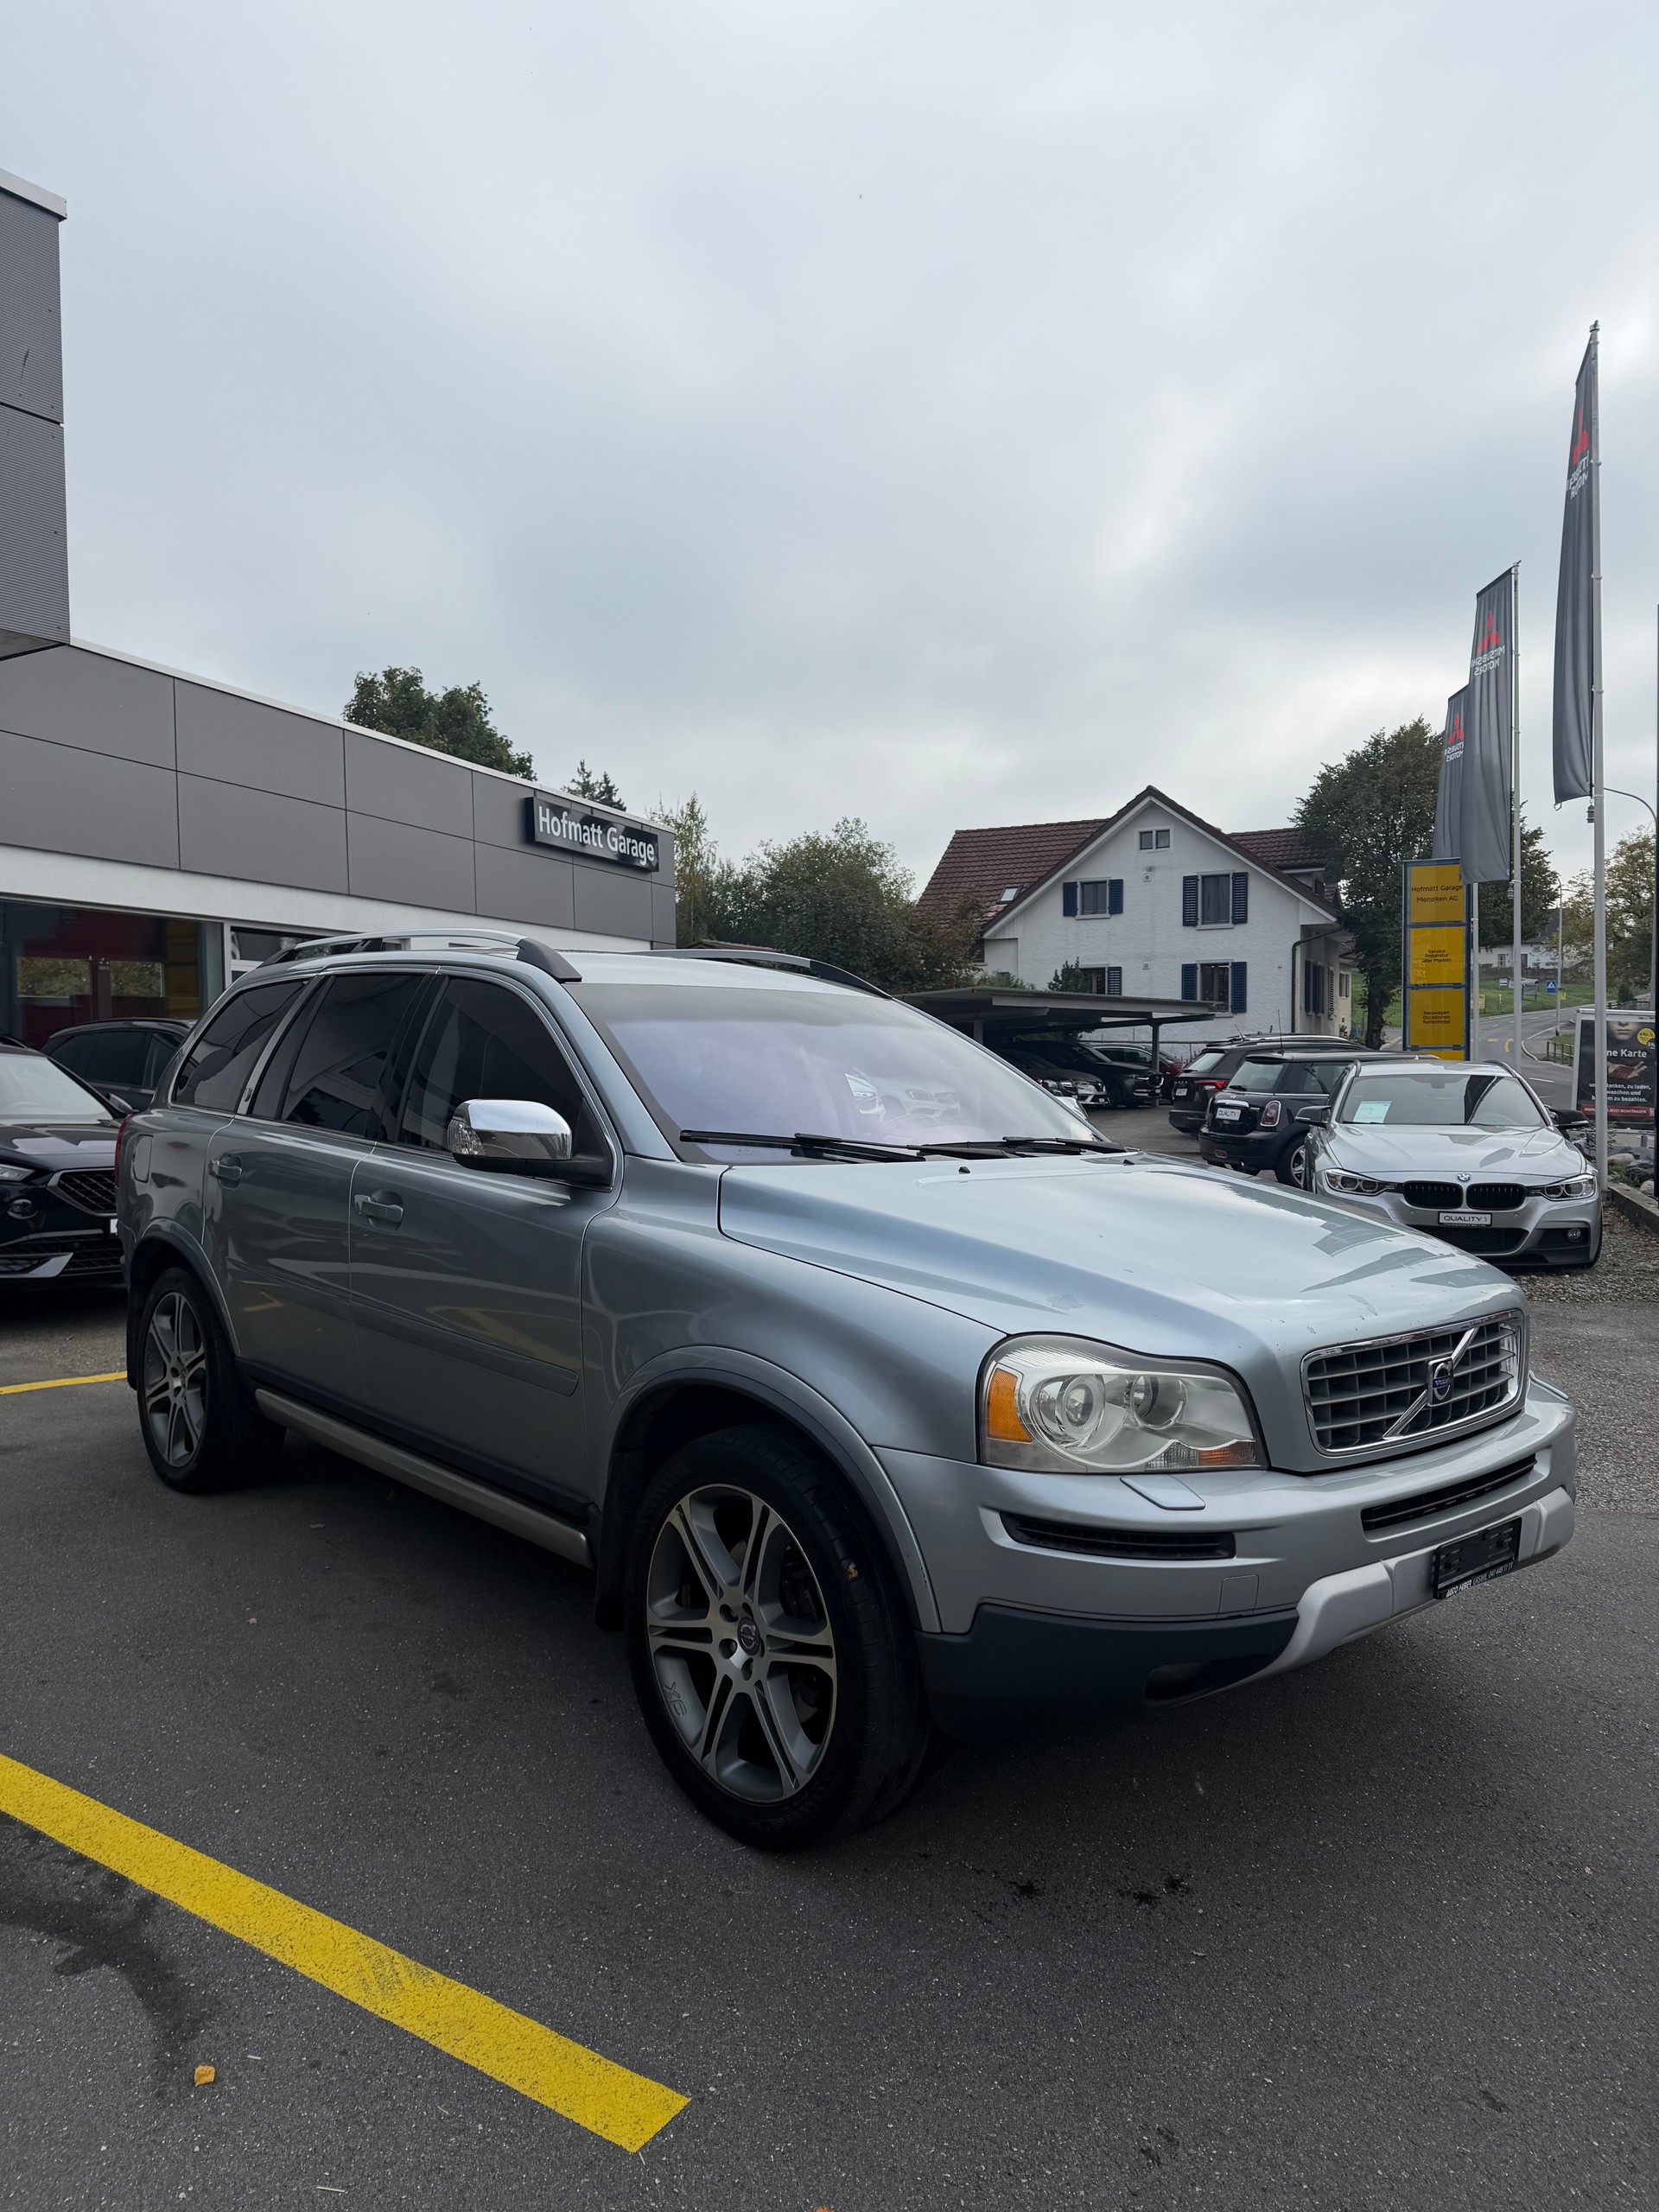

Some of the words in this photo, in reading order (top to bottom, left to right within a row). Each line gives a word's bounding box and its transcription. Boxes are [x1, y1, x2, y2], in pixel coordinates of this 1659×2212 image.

[538, 805, 603, 849] Hofmatt
[607, 826, 655, 866] Garage
[1620, 1048, 1648, 1058] Karte
[1219, 1109, 1236, 1118] QUALITY
